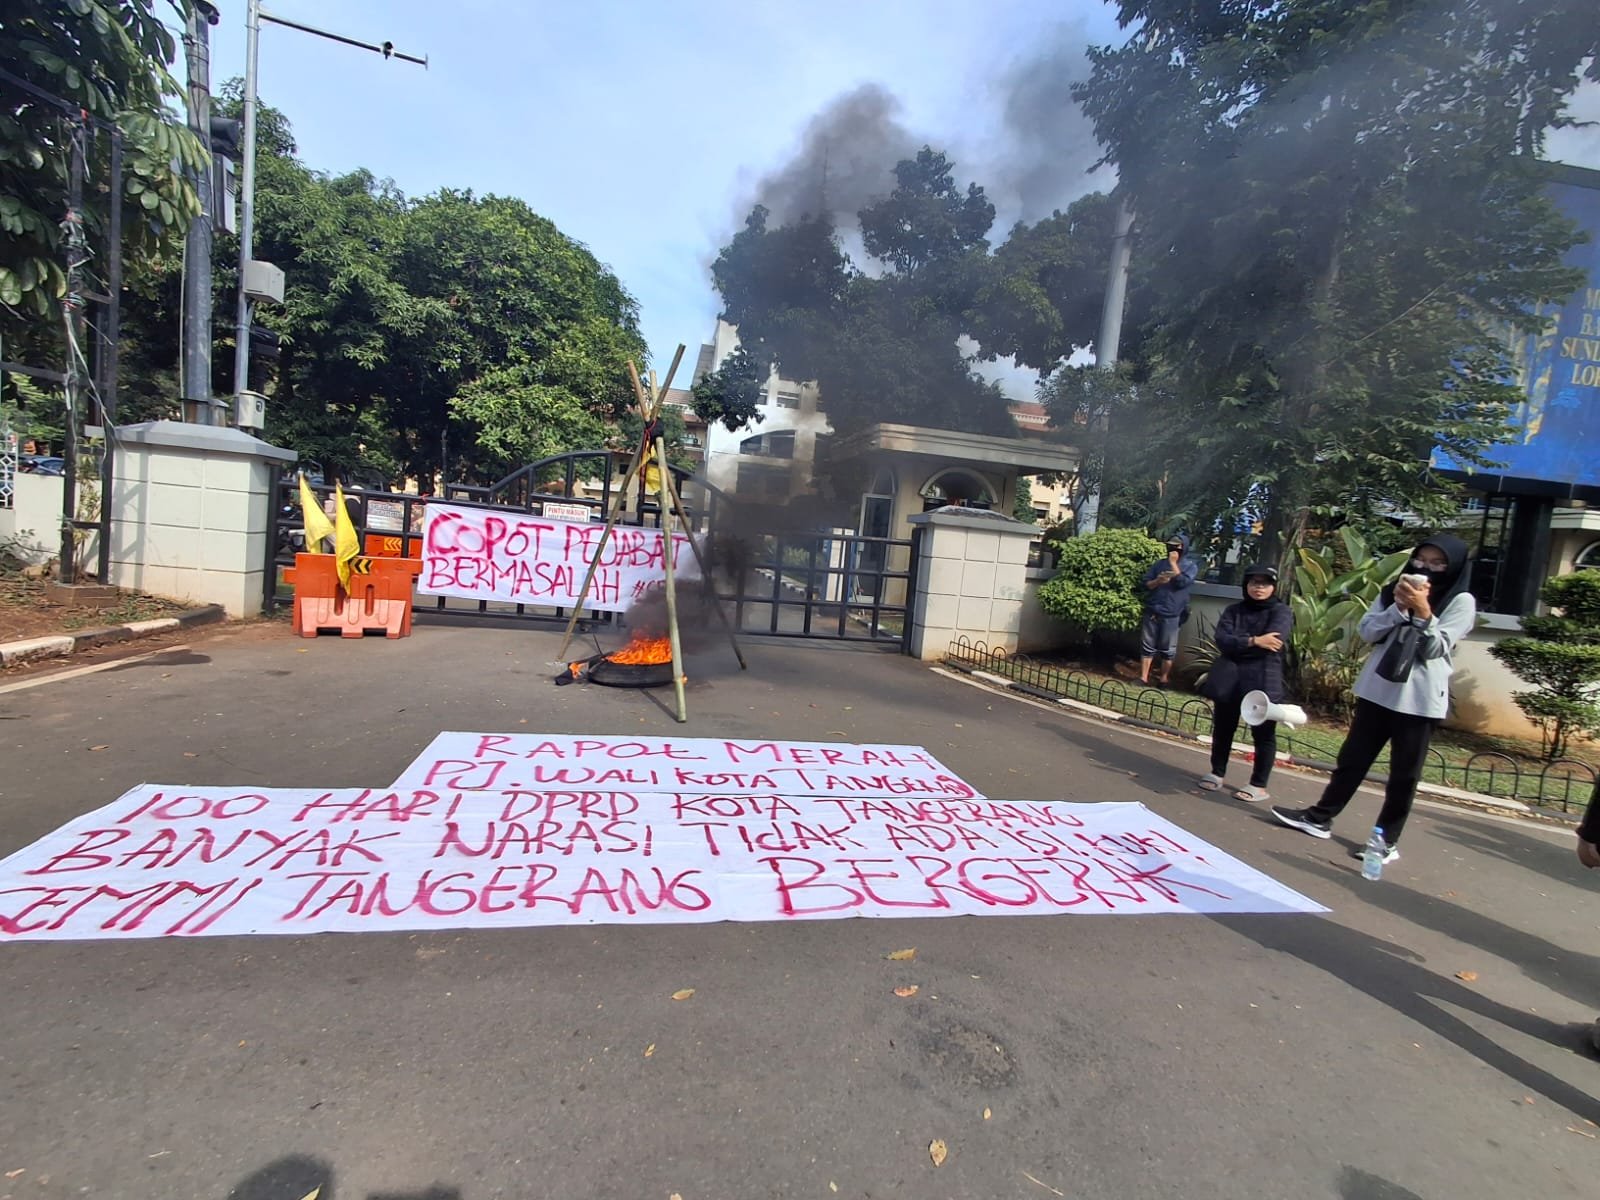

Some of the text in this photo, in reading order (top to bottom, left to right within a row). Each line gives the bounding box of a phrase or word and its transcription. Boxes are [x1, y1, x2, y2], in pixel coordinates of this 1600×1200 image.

[427, 512, 555, 560] COPOT
[564, 525, 692, 571] PEJABAT
[427, 556, 620, 604] BERMASALAH
[533, 765, 659, 785] WALI
[674, 767, 778, 789] KOTA
[723, 741, 937, 771] MERAH
[116, 793, 270, 824] 100
[291, 788, 463, 823] HARI
[499, 789, 639, 822] DPRD
[671, 795, 801, 820] KOTA
[23, 827, 402, 875] BANYAK
[432, 820, 653, 860] NARASI
[885, 823, 1000, 851] ADA
[281, 863, 712, 921] TANGERANG
[756, 854, 1234, 917] BERGERAK
